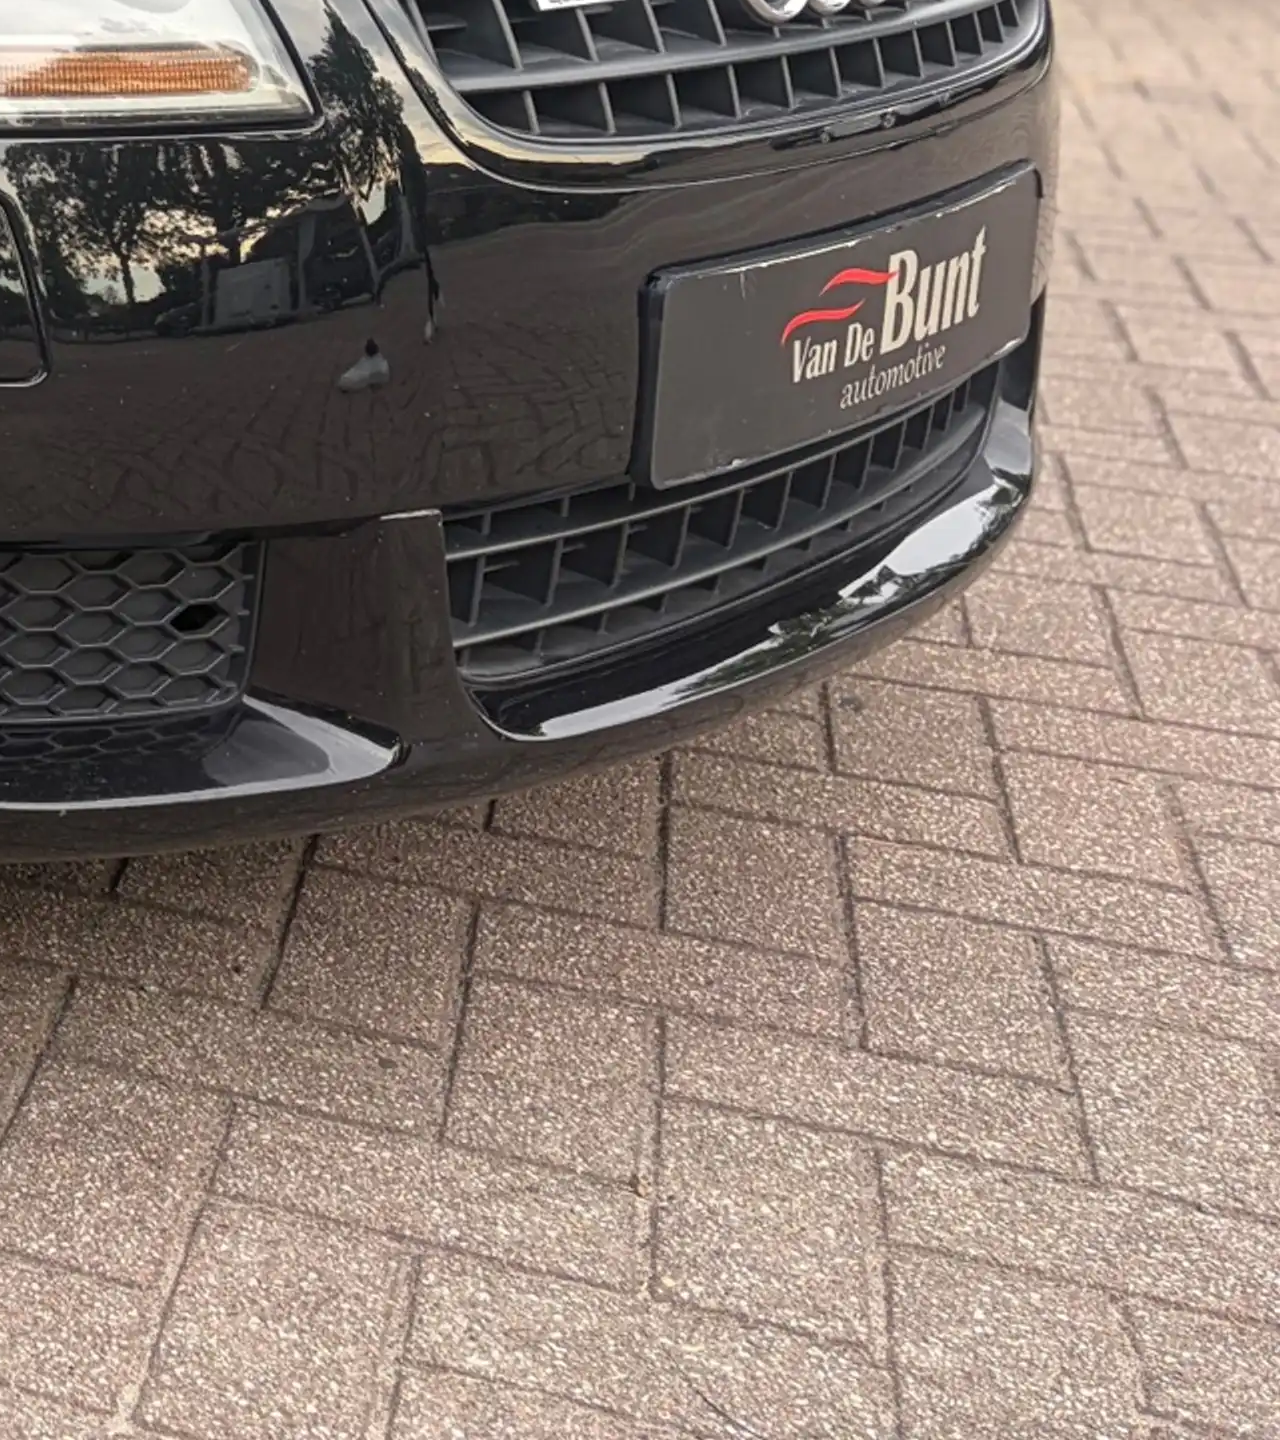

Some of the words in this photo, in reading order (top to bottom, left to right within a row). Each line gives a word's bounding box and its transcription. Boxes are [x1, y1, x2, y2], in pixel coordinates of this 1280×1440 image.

[792, 336, 838, 384] Van
[844, 321, 876, 368] De
[879, 224, 987, 356] Bunt
[839, 342, 947, 410] automotive
